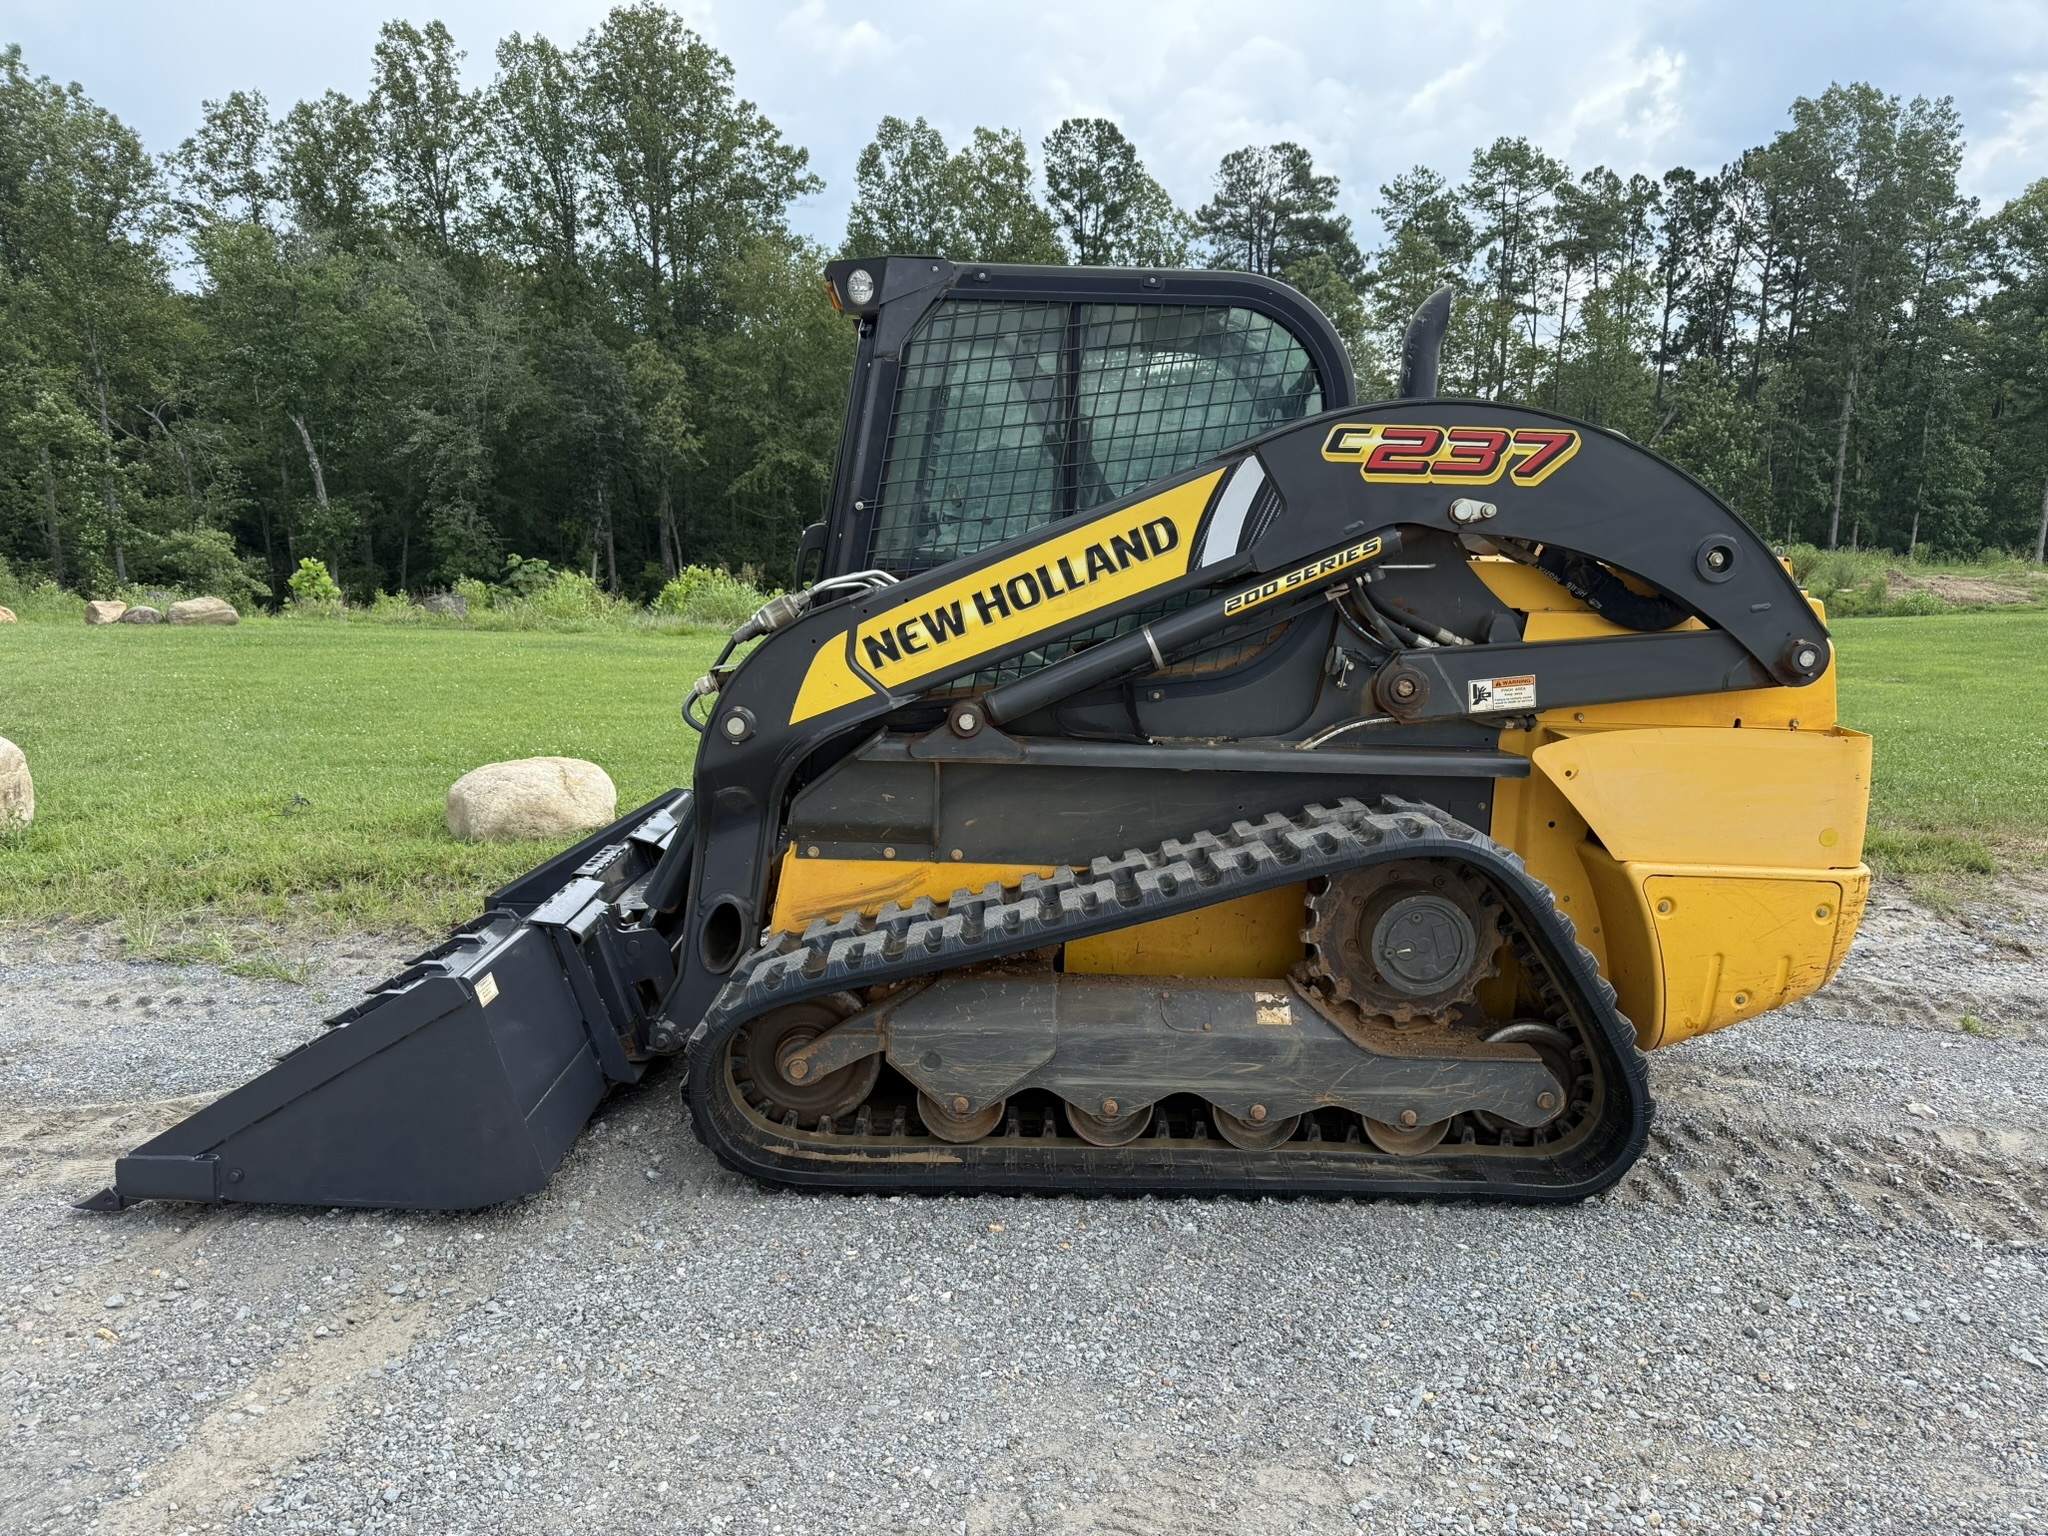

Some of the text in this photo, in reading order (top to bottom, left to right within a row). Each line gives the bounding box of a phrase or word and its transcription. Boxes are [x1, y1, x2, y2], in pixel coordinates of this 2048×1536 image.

[861, 515, 1181, 670] NEW HOLLAND
[1226, 538, 1378, 613] 200 SERIES
